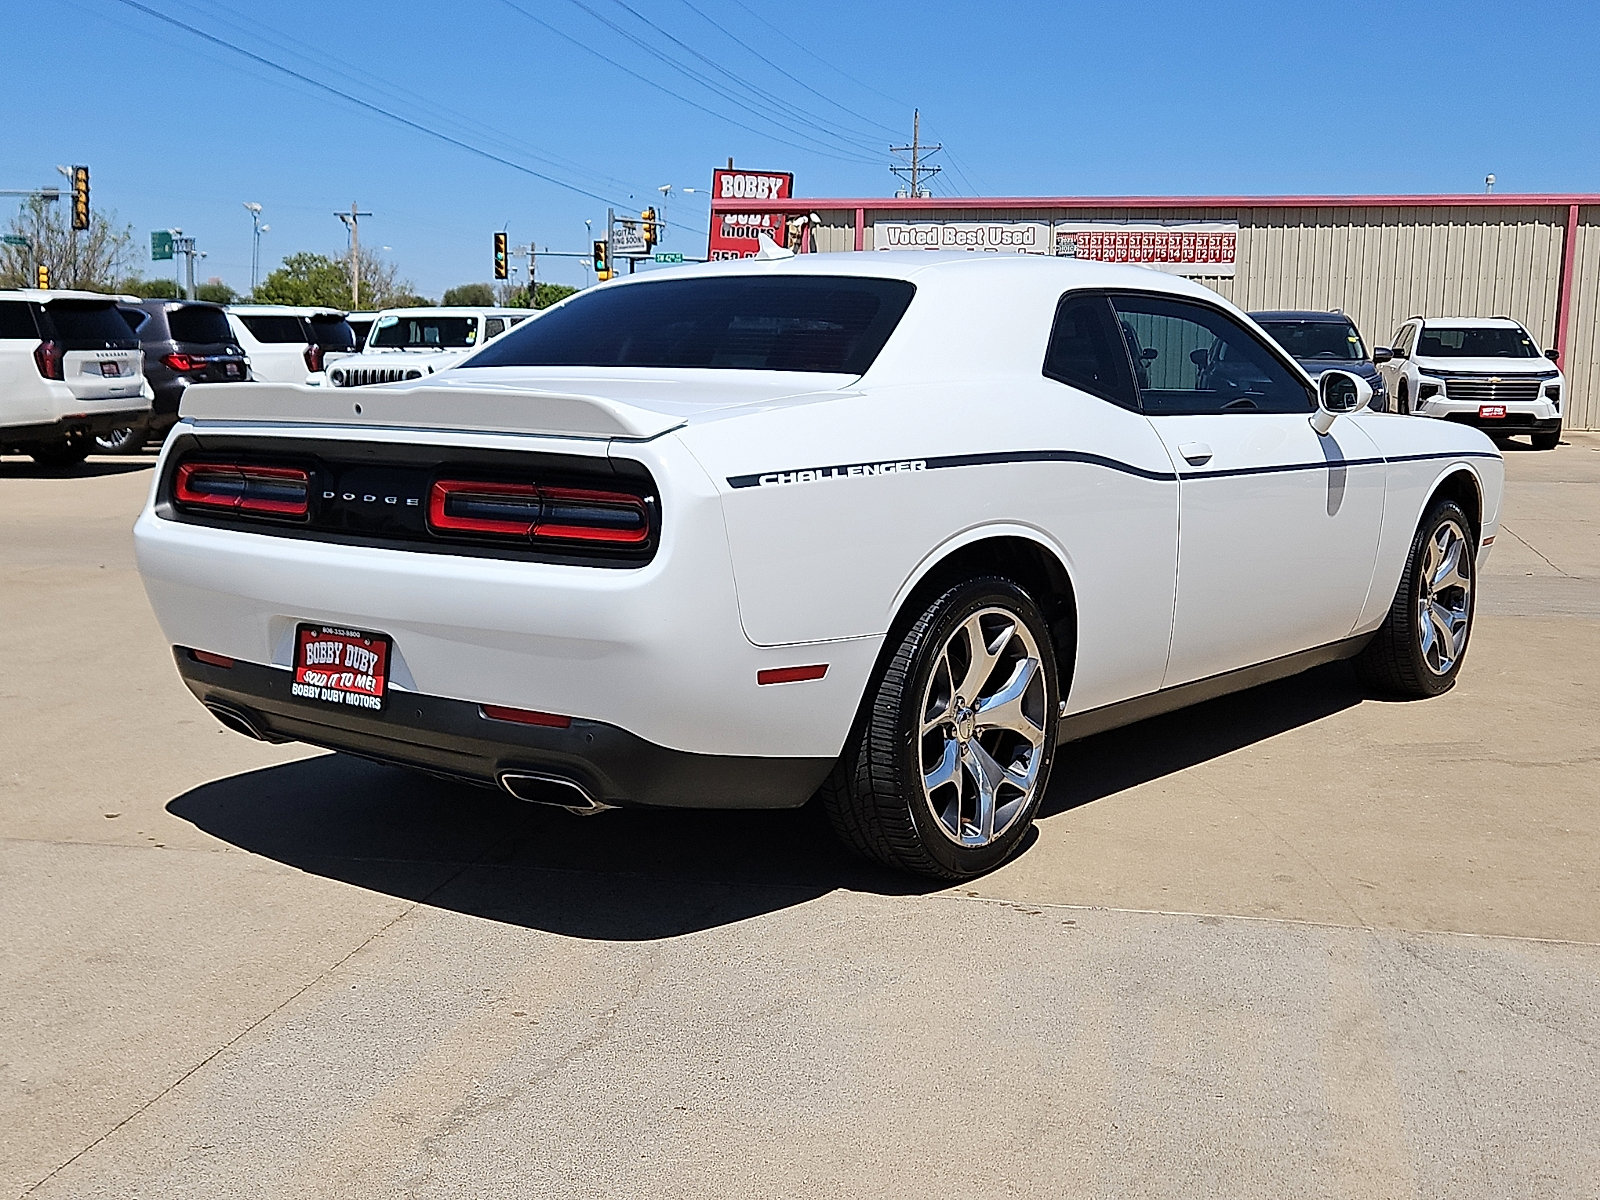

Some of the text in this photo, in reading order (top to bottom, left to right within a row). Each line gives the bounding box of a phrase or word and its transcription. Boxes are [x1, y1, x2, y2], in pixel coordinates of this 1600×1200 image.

[721, 174, 783, 199] BOBBY
[887, 227, 1035, 245] Voted Best Used
[1077, 249, 1234, 258] 22 21 20 19 18 17 15 14 13 12 11 10
[758, 460, 926, 487] CHALLENGER
[322, 491, 419, 506] DODGE
[306, 641, 378, 675] BOBBY DUBY
[303, 670, 377, 692] SOLD IT TO ME!
[292, 683, 381, 710] BOBBY DUBY MOTORS
